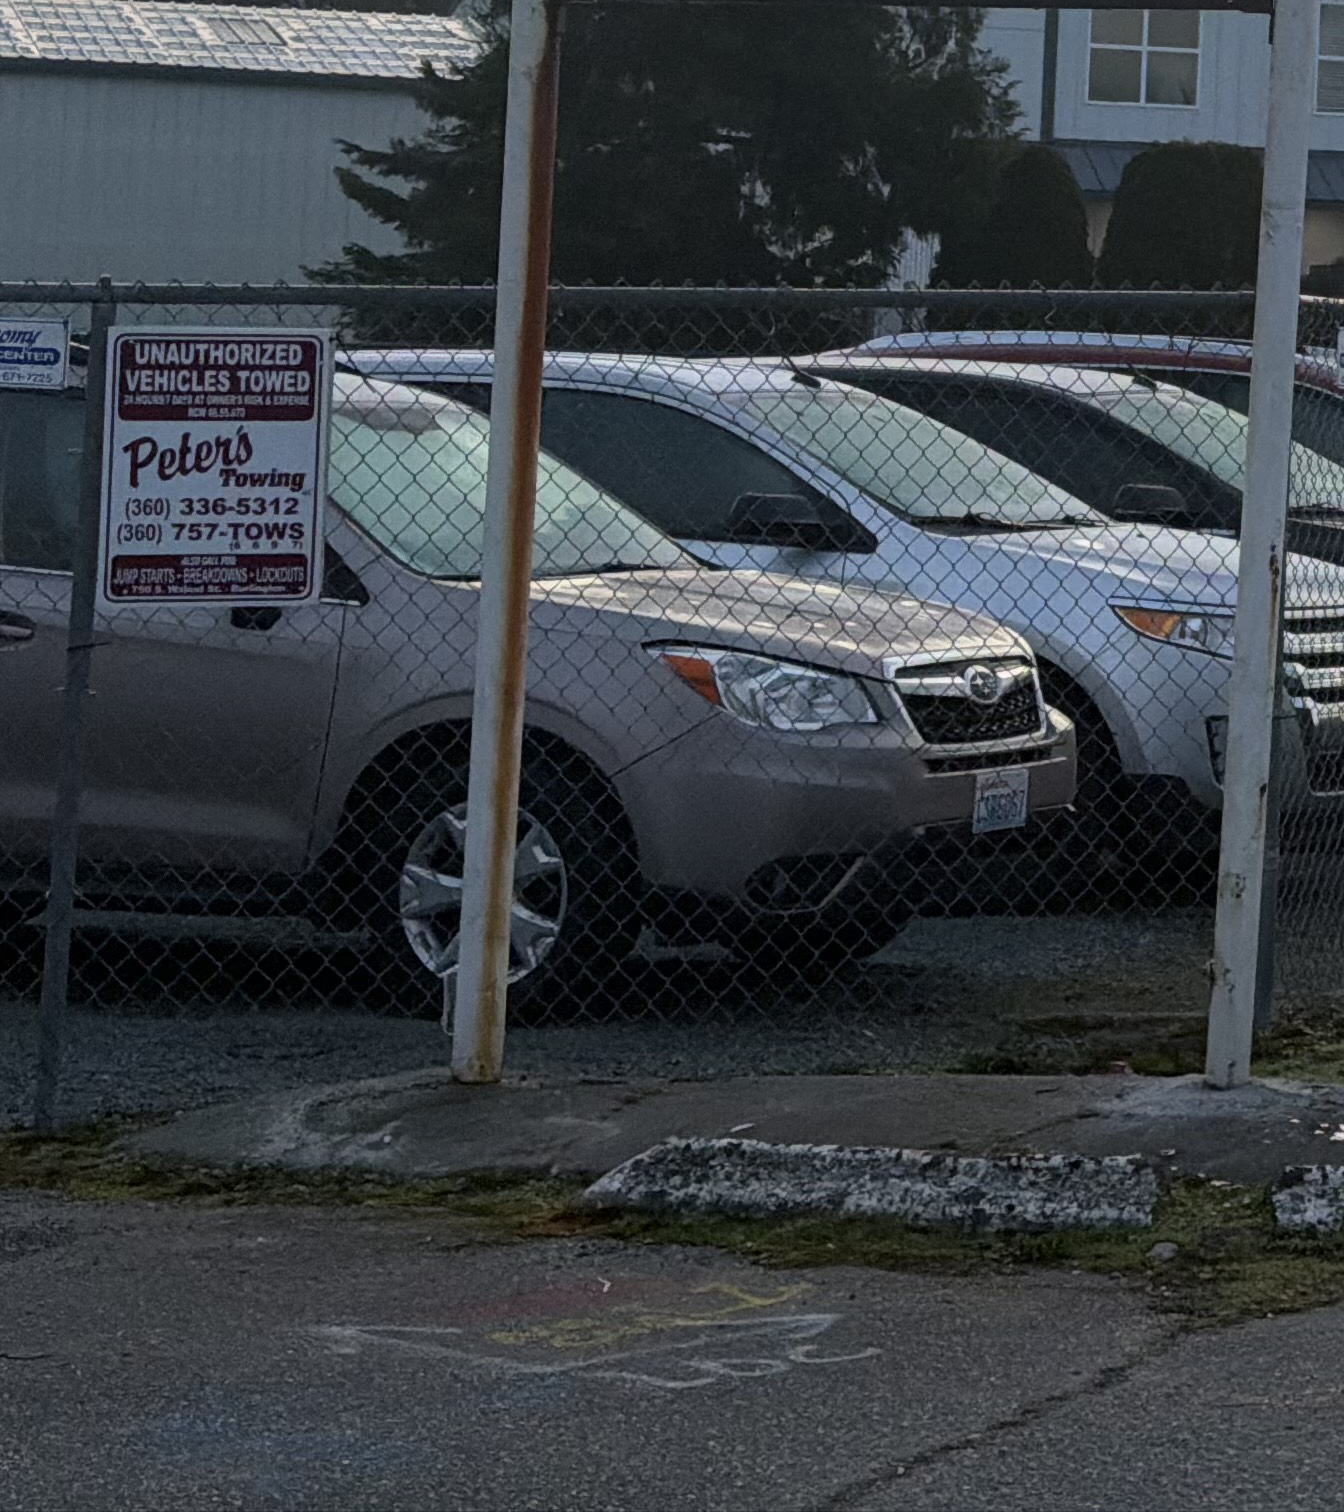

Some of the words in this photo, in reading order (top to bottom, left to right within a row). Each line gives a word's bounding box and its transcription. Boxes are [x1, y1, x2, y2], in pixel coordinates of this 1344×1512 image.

[135, 343, 303, 365] UNAUTHORIZED
[125, 370, 231, 392] VEHICLES
[237, 370, 310, 392] TOWED
[122, 425, 253, 488] Peter's
[219, 468, 306, 492] Towing
[125, 498, 171, 521] (360)
[179, 497, 299, 516] 336-5312
[117, 523, 162, 544] (360)
[170, 522, 305, 541] 757-TOWS
[140, 568, 175, 584] STARTS
[256, 567, 304, 584] LOCKOUTS
